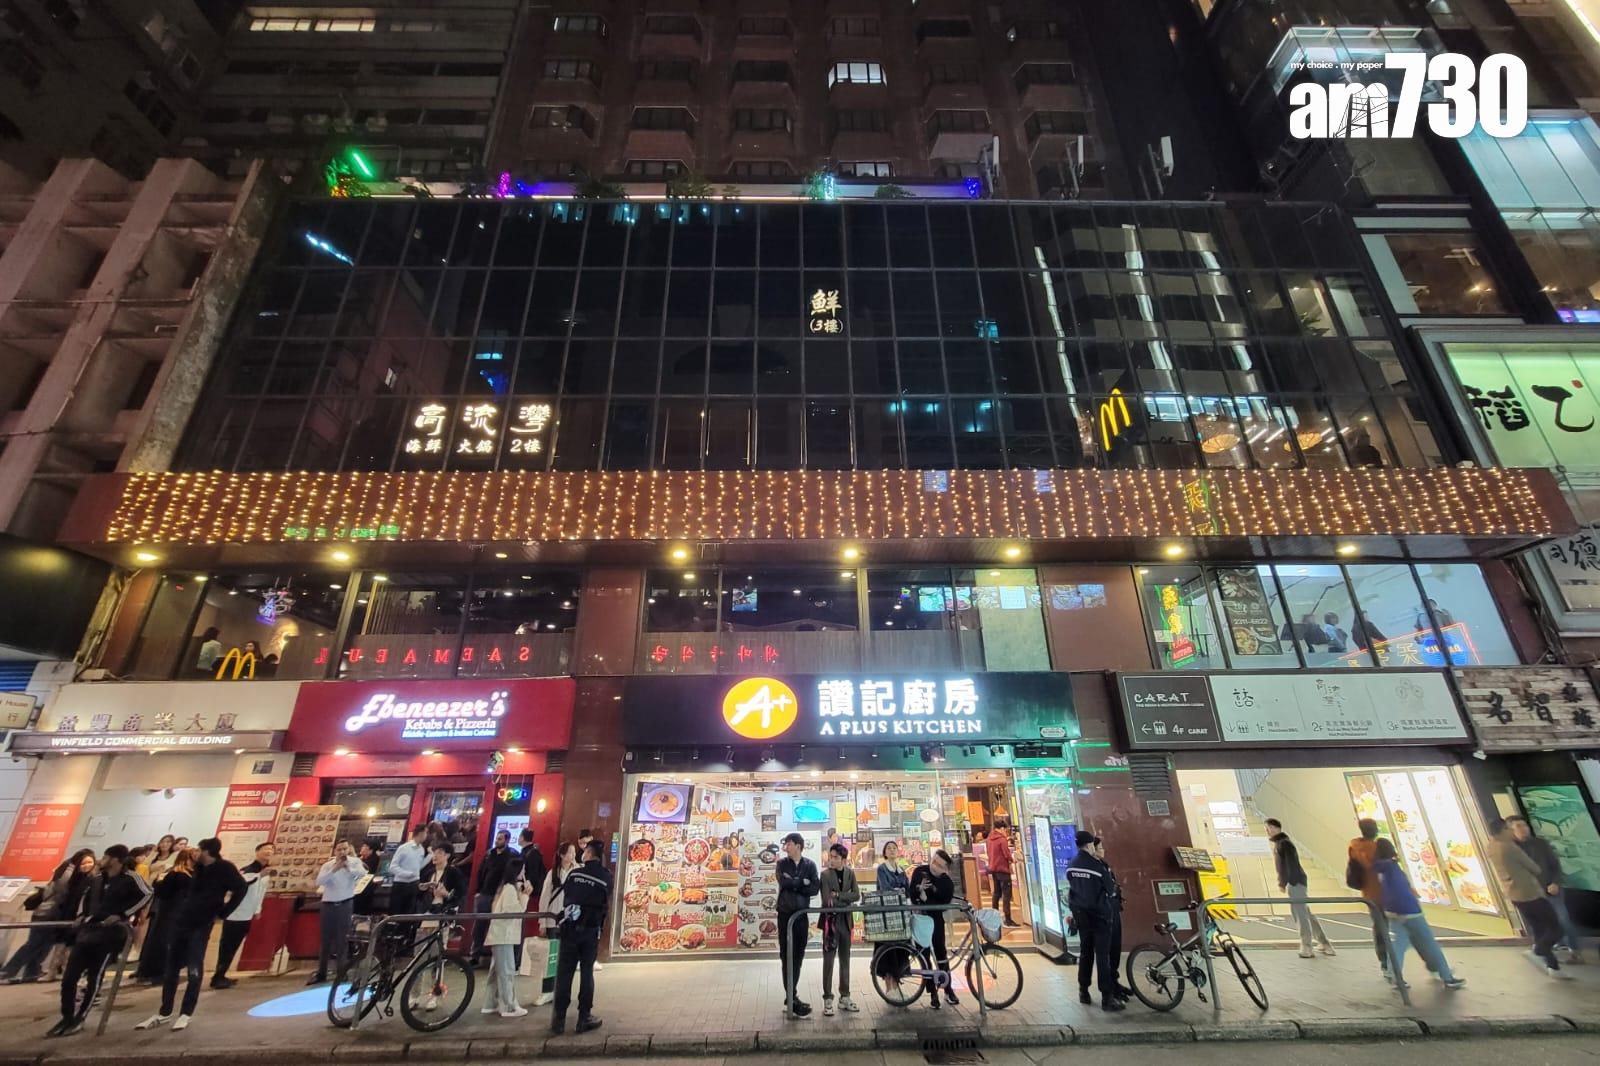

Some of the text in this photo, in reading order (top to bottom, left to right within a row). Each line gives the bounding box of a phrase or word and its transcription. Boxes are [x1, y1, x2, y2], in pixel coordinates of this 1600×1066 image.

[811, 289, 842, 318] 鮮
[810, 318, 843, 333] (3樓)
[414, 404, 551, 436] 高流灣
[406, 439, 541, 453] 海鮮 火鍋 2樓
[818, 678, 979, 717] 讚記廚房
[1134, 692, 1190, 703] CARAT
[405, 718, 496, 729] Kebabs & Pizzeria
[820, 719, 982, 735] A PLUS KITCHEN
[1172, 724, 1185, 734] 4F
[1311, 721, 1324, 732] 2F
[1386, 720, 1400, 731] 3F
[51, 736, 232, 746] WINFIELD COMMERCIAL BUILDING
